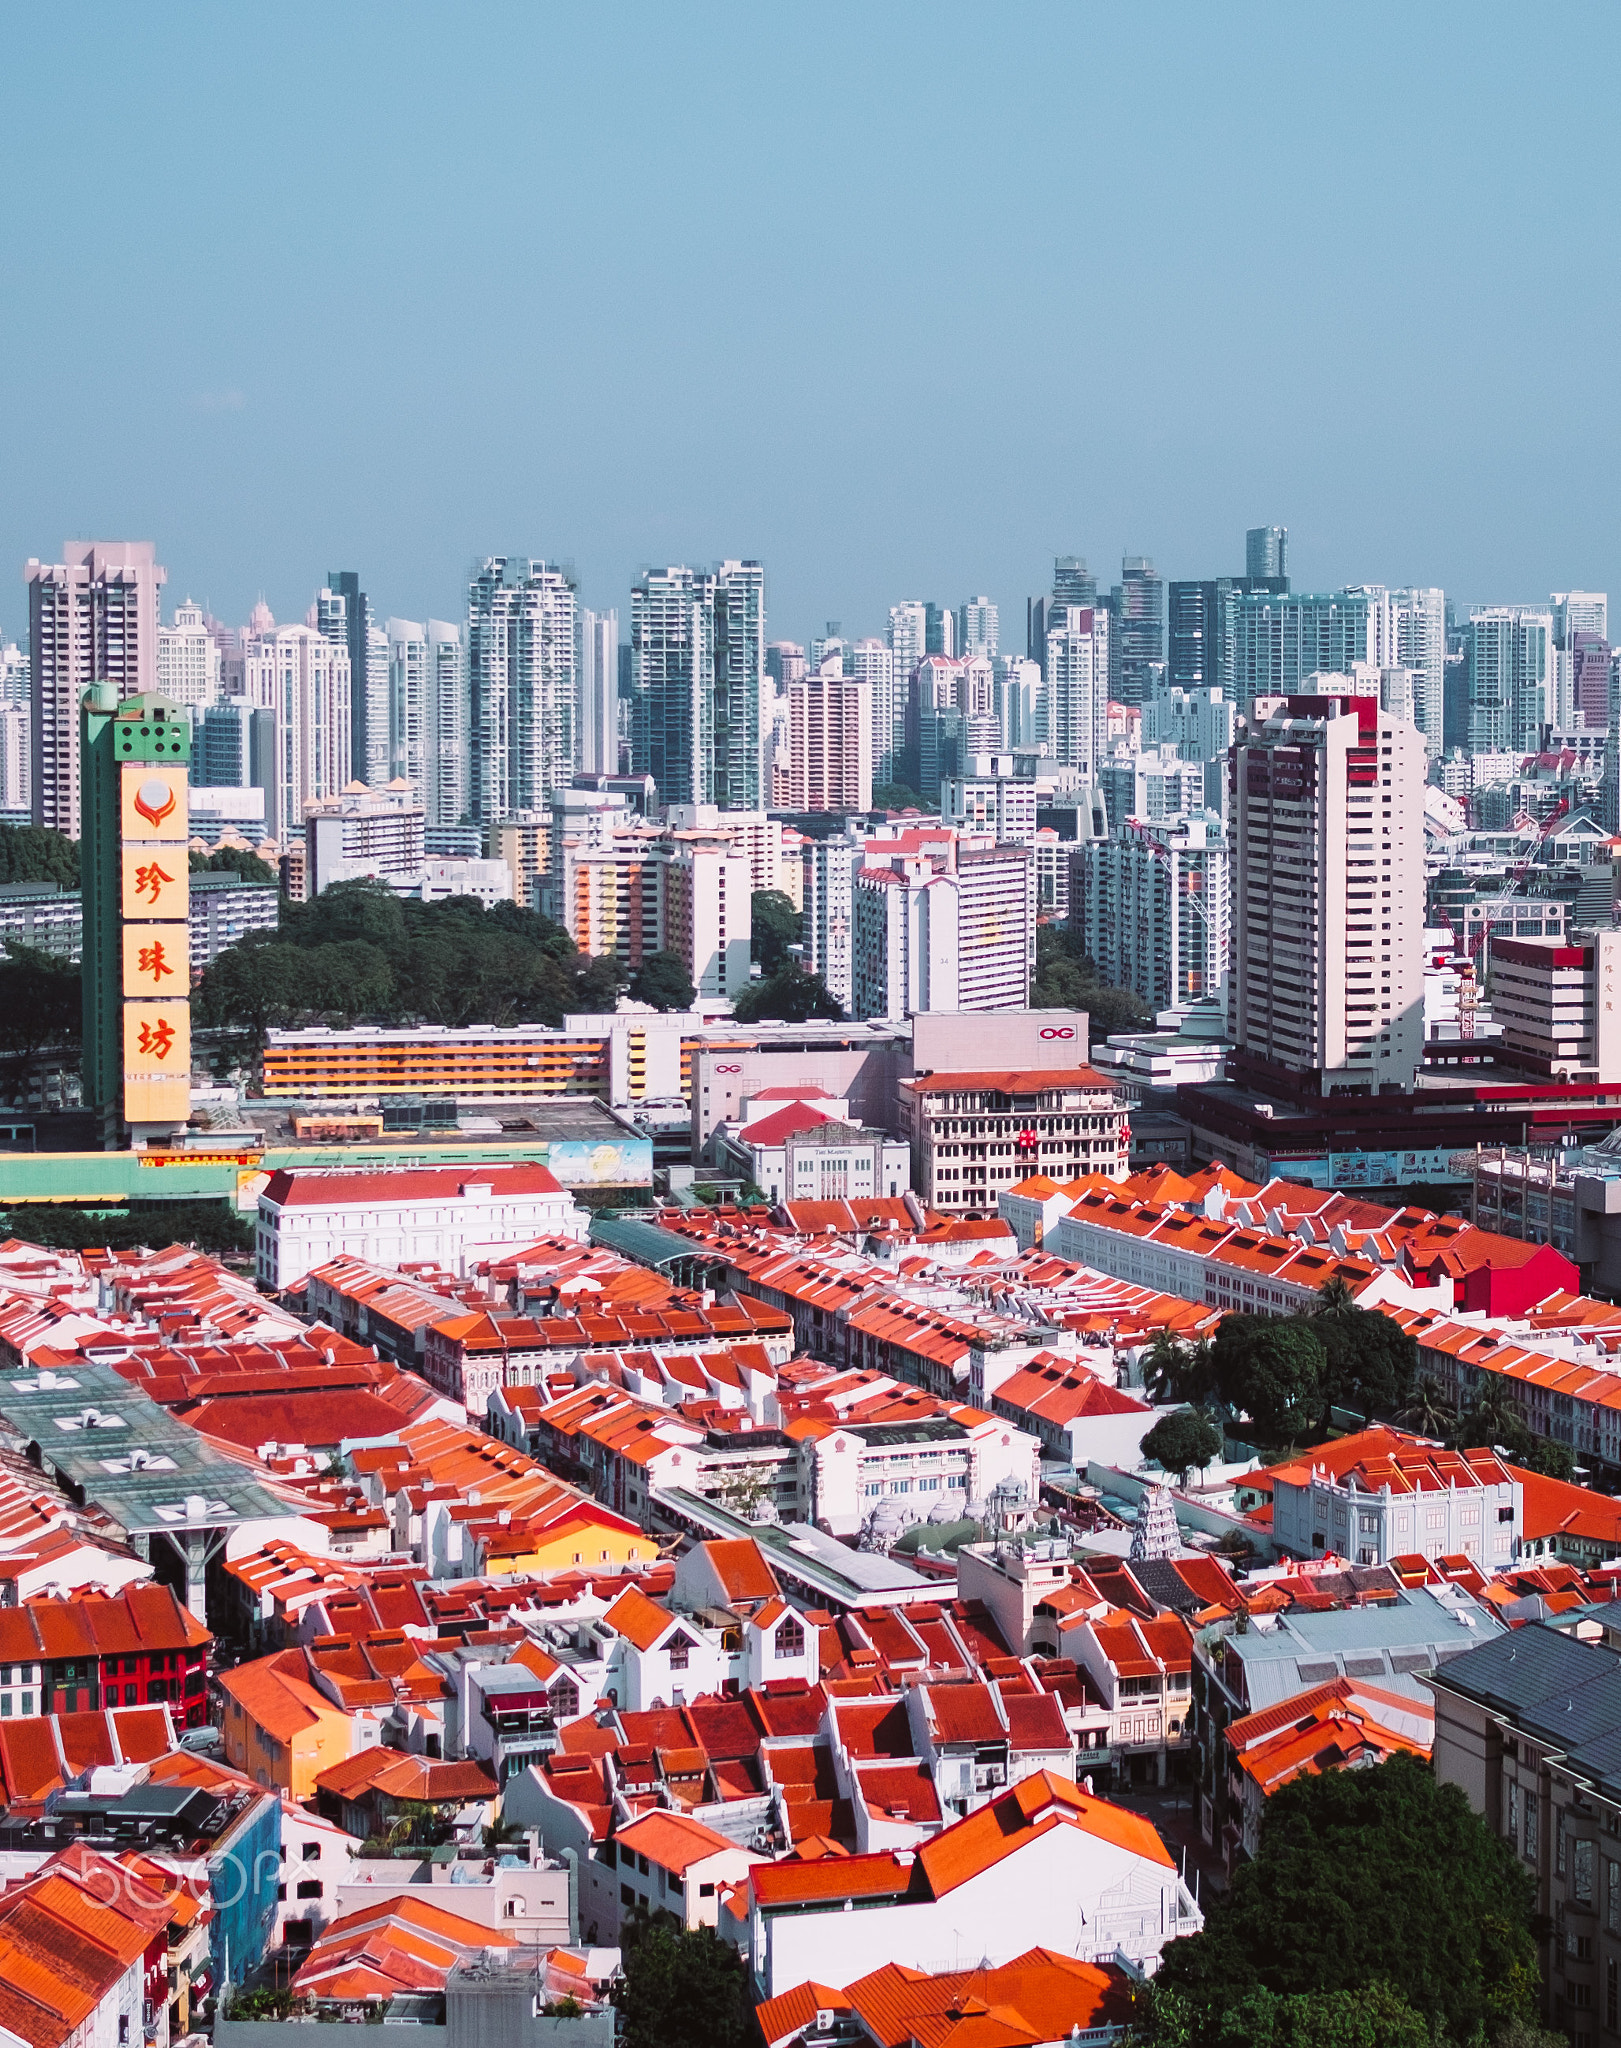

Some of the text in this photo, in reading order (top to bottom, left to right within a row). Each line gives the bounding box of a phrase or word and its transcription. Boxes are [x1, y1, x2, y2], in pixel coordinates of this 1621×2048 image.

[135, 862, 175, 1060] 珍珠坊
[1040, 1027, 1075, 1039] OG
[716, 1065, 741, 1073] OG
